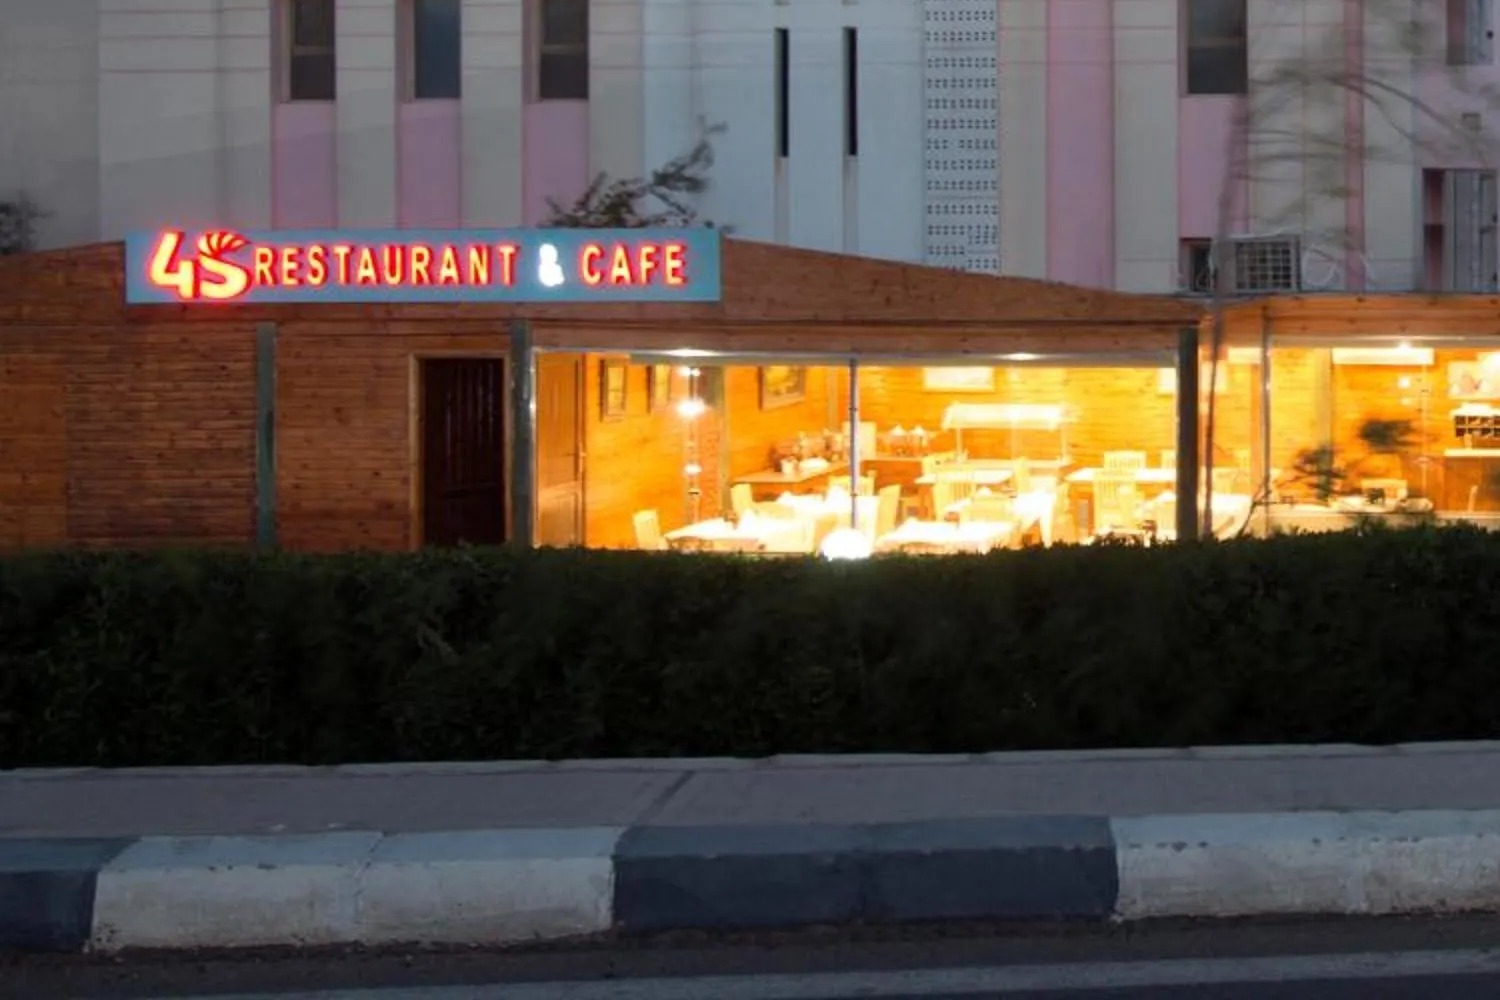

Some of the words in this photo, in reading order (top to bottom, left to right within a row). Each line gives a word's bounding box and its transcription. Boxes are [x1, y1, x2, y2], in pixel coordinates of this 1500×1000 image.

[148, 230, 252, 300] 4S
[254, 243, 520, 288] RESTAURANT
[537, 242, 565, 287] &
[579, 243, 689, 288] CAFE
